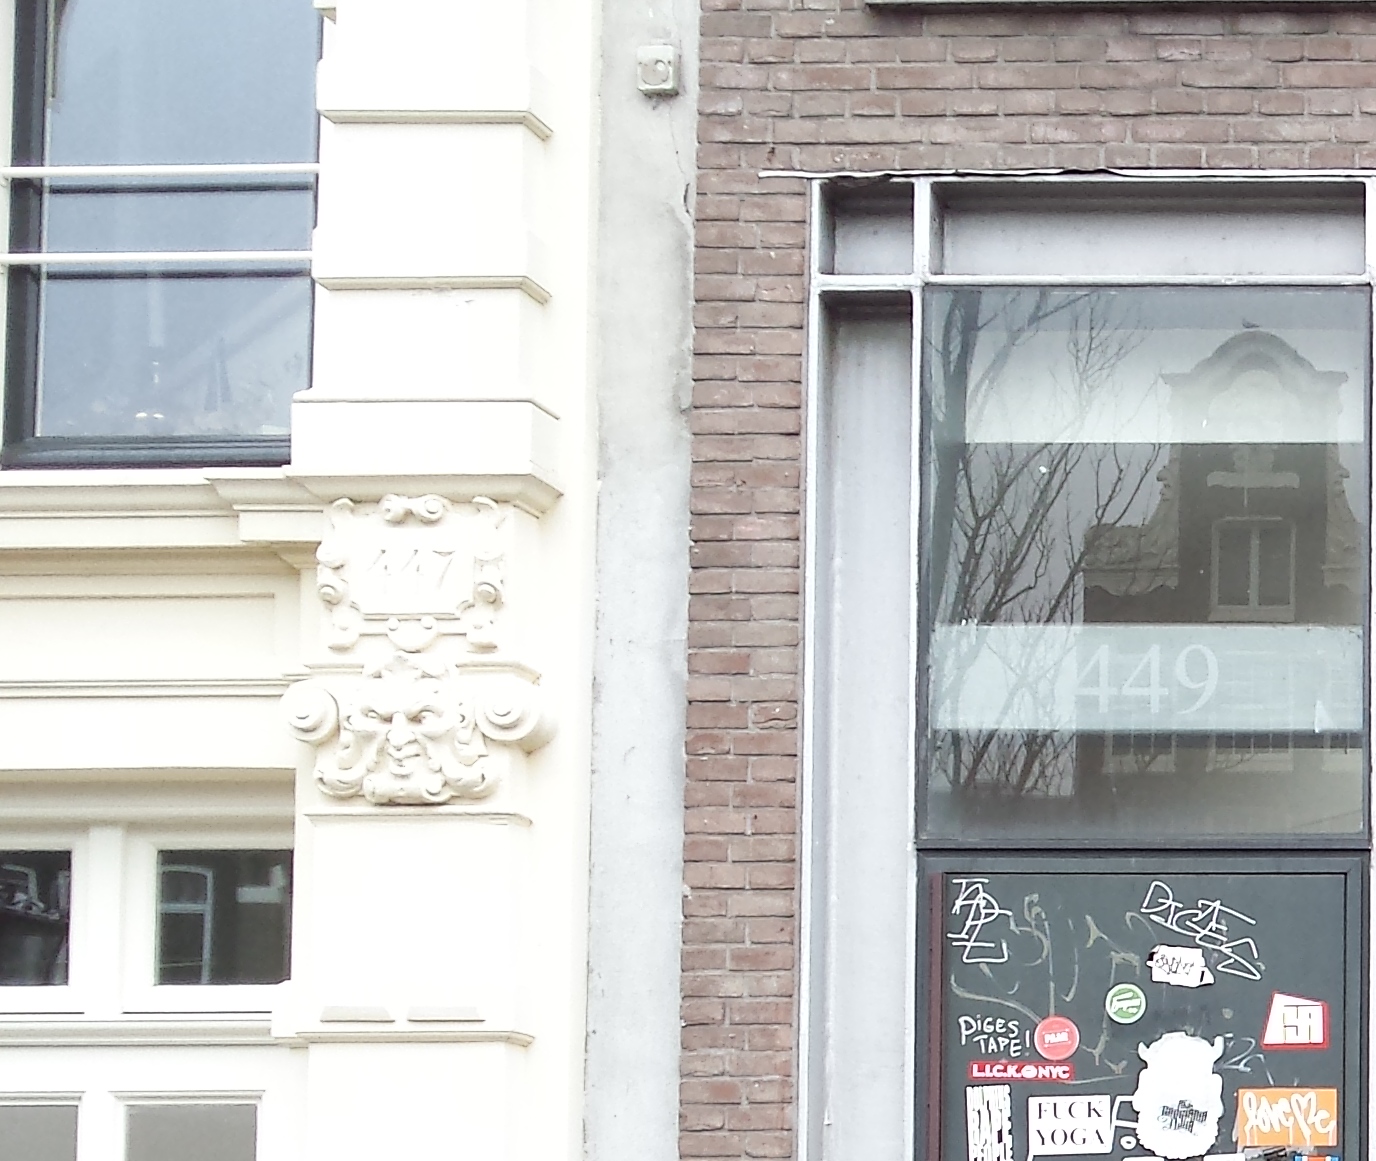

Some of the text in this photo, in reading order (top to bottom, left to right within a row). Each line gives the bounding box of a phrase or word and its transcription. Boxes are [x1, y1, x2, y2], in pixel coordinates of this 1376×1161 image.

[1075, 644, 1220, 714] 449
[1037, 1101, 1103, 1119] FUCK
[1036, 1127, 1106, 1146] YOGA
